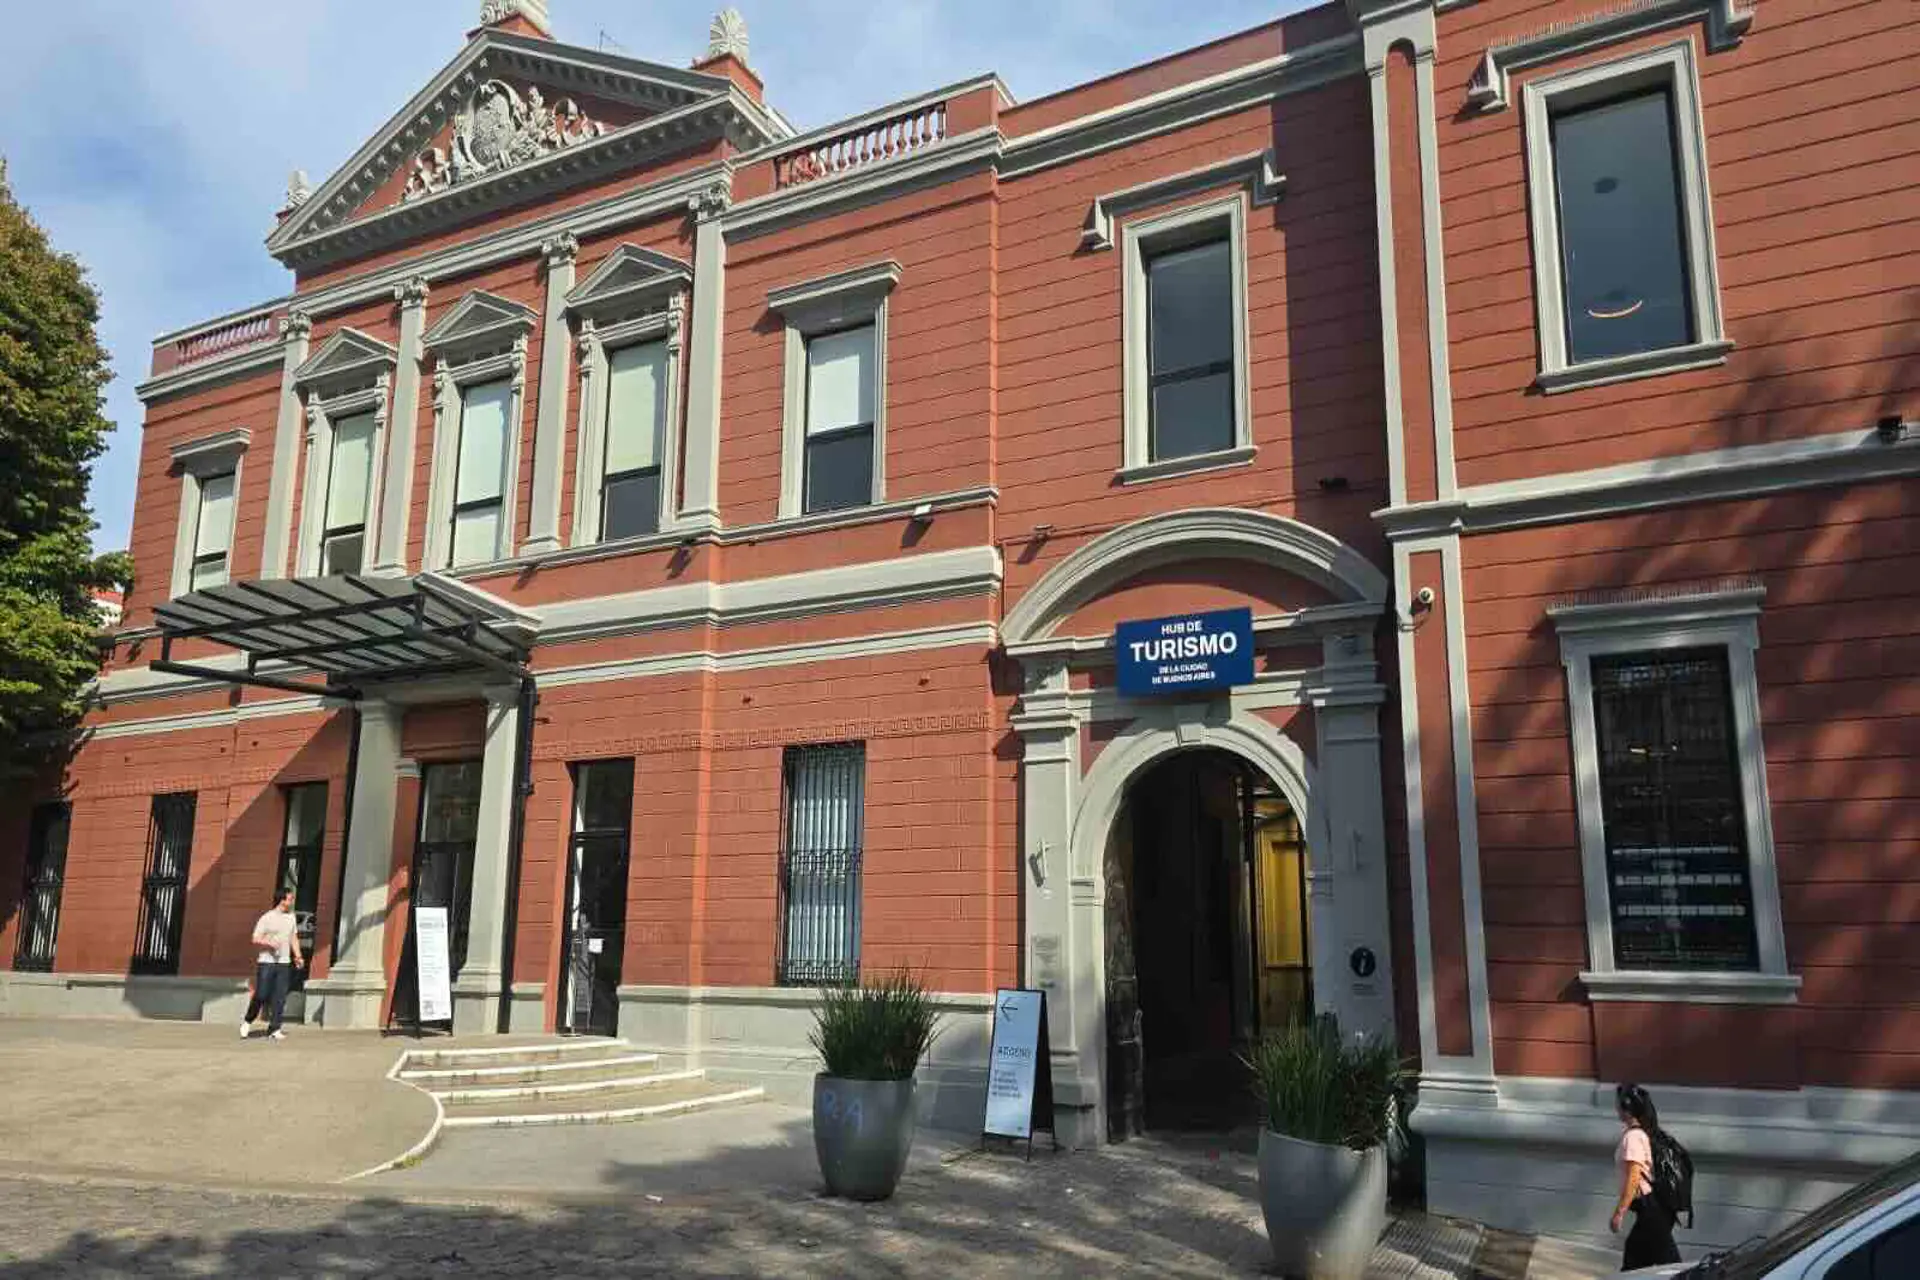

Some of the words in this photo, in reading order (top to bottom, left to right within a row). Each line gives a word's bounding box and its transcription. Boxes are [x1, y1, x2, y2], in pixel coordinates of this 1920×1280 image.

[1161, 623, 1185, 636] HUB
[1187, 620, 1203, 633] DE
[1130, 631, 1238, 662] TURISMO
[1159, 665, 1169, 674] DE
[1169, 664, 1180, 673] LA
[1180, 662, 1208, 673] CIUDAD
[1151, 676, 1162, 684] DE
[1163, 673, 1193, 684] BUENOS
[1193, 670, 1216, 681] AIRES
